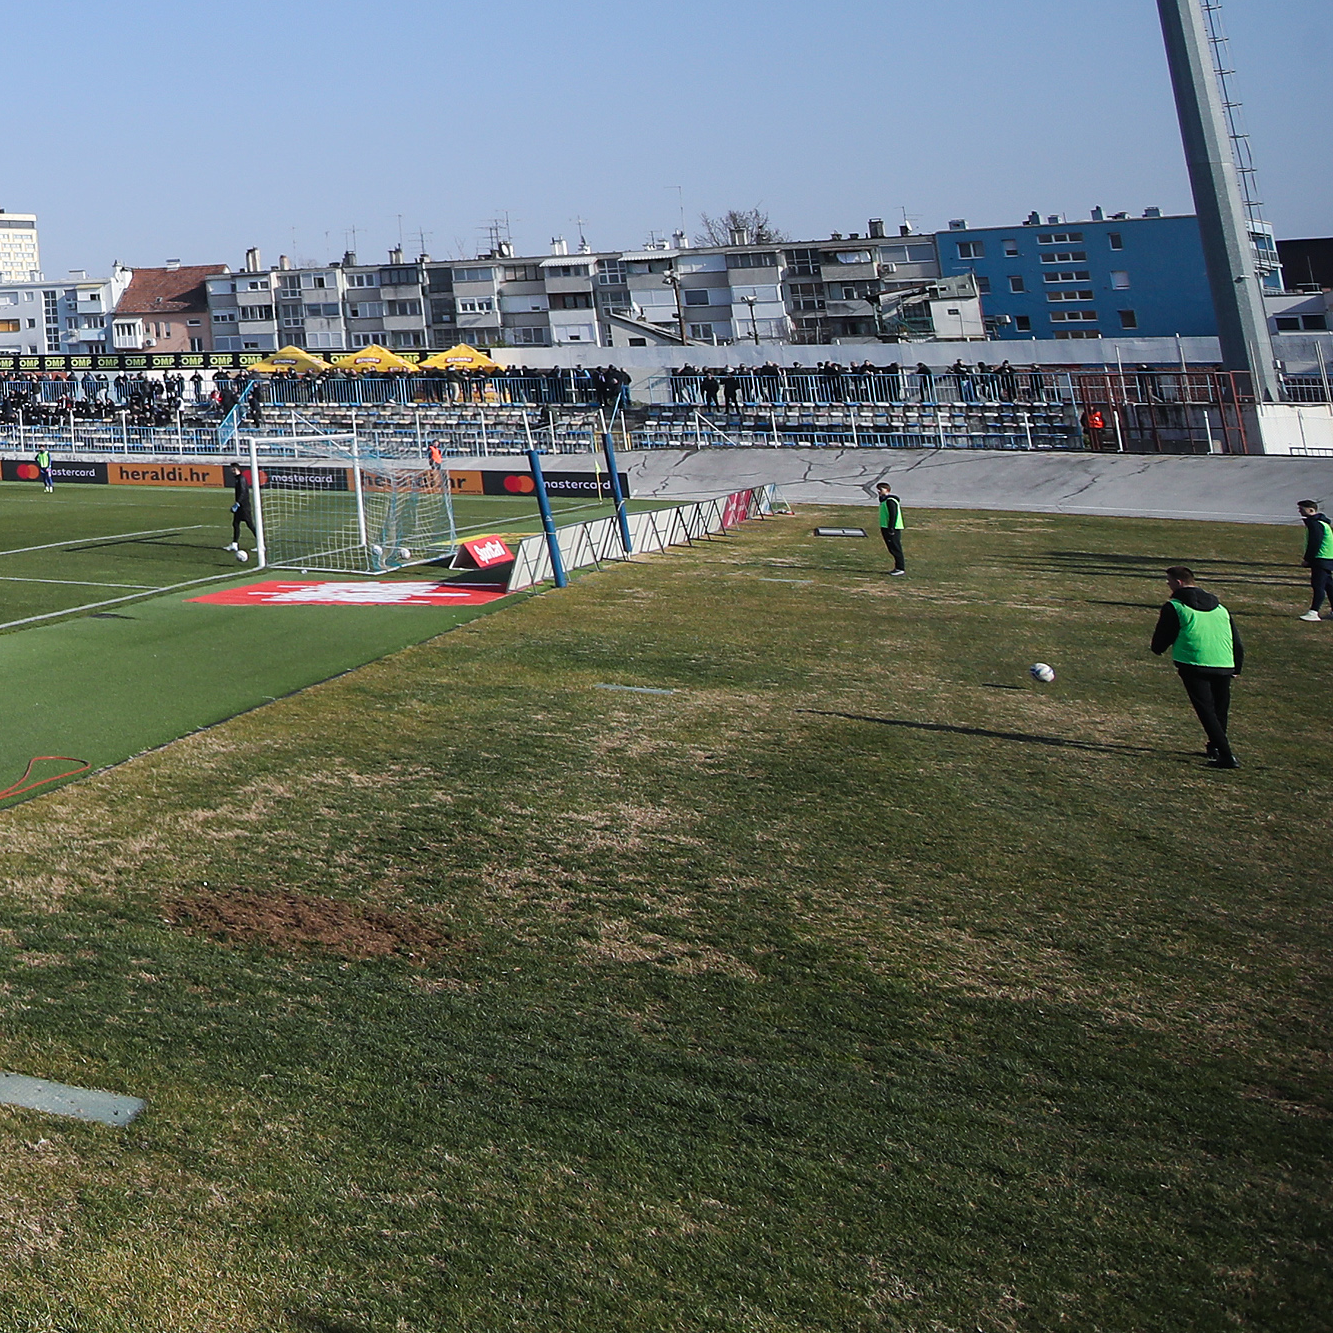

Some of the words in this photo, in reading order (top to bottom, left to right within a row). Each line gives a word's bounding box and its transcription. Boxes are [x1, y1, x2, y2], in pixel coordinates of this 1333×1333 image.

[19, 358, 39, 367] OMP
[45, 358, 65, 367] OMP
[71, 358, 91, 367] OMP
[98, 358, 118, 367] OMP
[125, 357, 146, 366] OMP
[153, 357, 175, 366] OMP
[182, 357, 203, 366] OMP
[210, 356, 233, 366] OMP
[51, 468, 96, 477] astercard
[119, 466, 210, 482] heraldi.hr
[271, 474, 333, 483] mastercard
